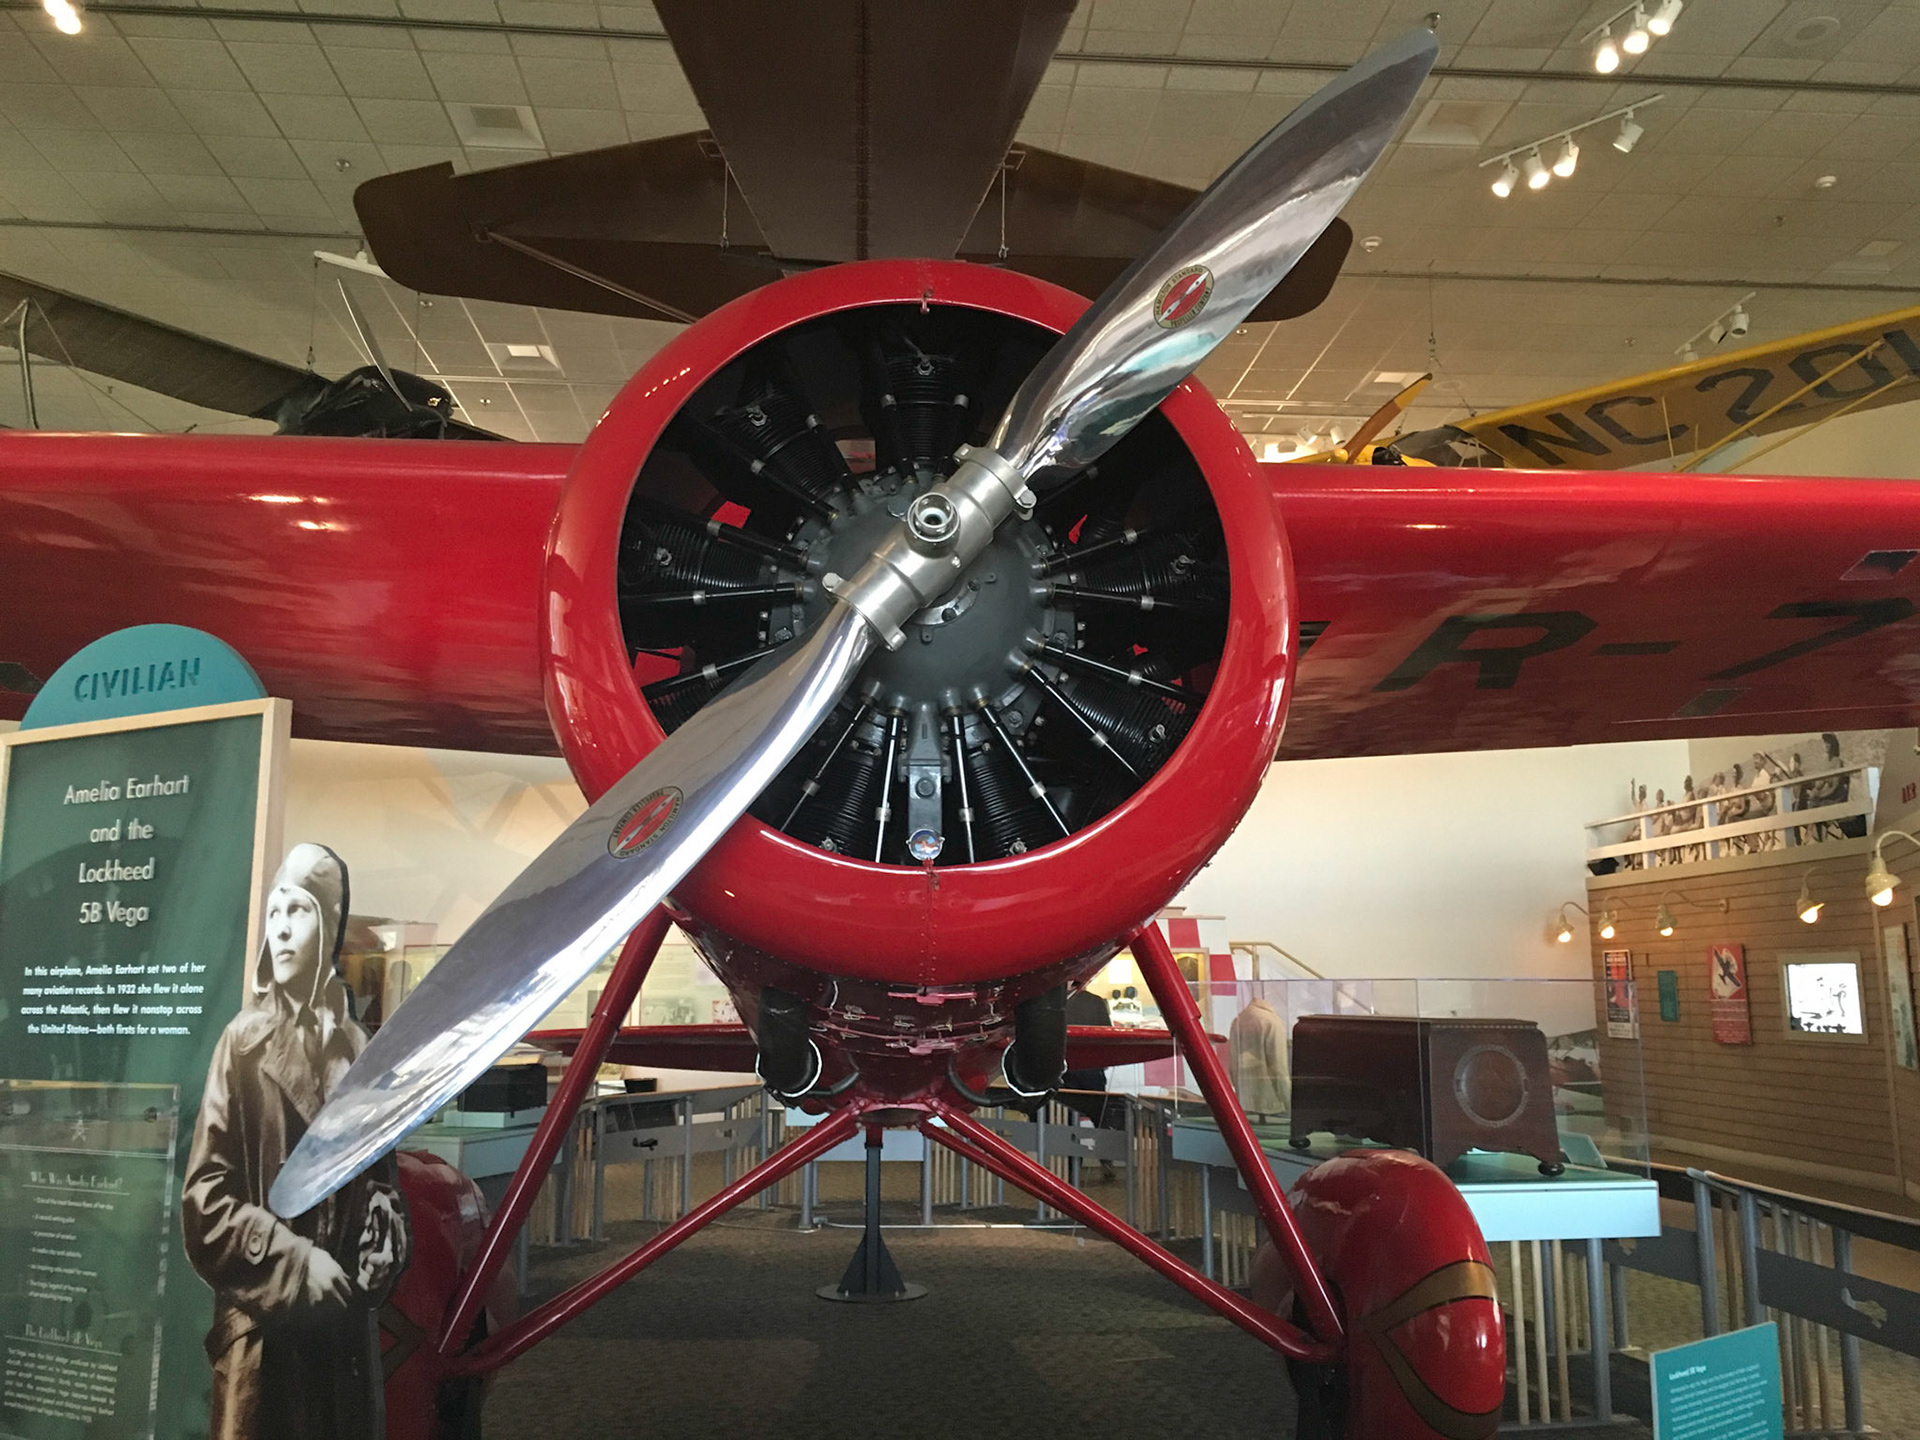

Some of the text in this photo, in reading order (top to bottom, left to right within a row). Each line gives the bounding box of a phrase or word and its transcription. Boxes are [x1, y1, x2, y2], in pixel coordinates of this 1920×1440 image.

[1299, 597, 1913, 693] R-7
[74, 657, 200, 702] CIVILIAN
[63, 774, 190, 805] Amelia Earhart
[90, 817, 155, 843] and the
[78, 857, 156, 883] Lockheed
[78, 900, 150, 927] 5B Vega
[24, 962, 206, 978] In this airplane, Amelia Earhart set two of her
[22, 983, 204, 997] many aviation records. In 1932 she flew it alone
[21, 1004, 202, 1016] across the Atlantic, then flew it nonstop across
[27, 1023, 40, 1034] the
[41, 1023, 65, 1034] United
[116, 1023, 135, 1035] firsts
[137, 1023, 149, 1034] for
[150, 1026, 156, 1035] a
[158, 1026, 191, 1035] woman.
